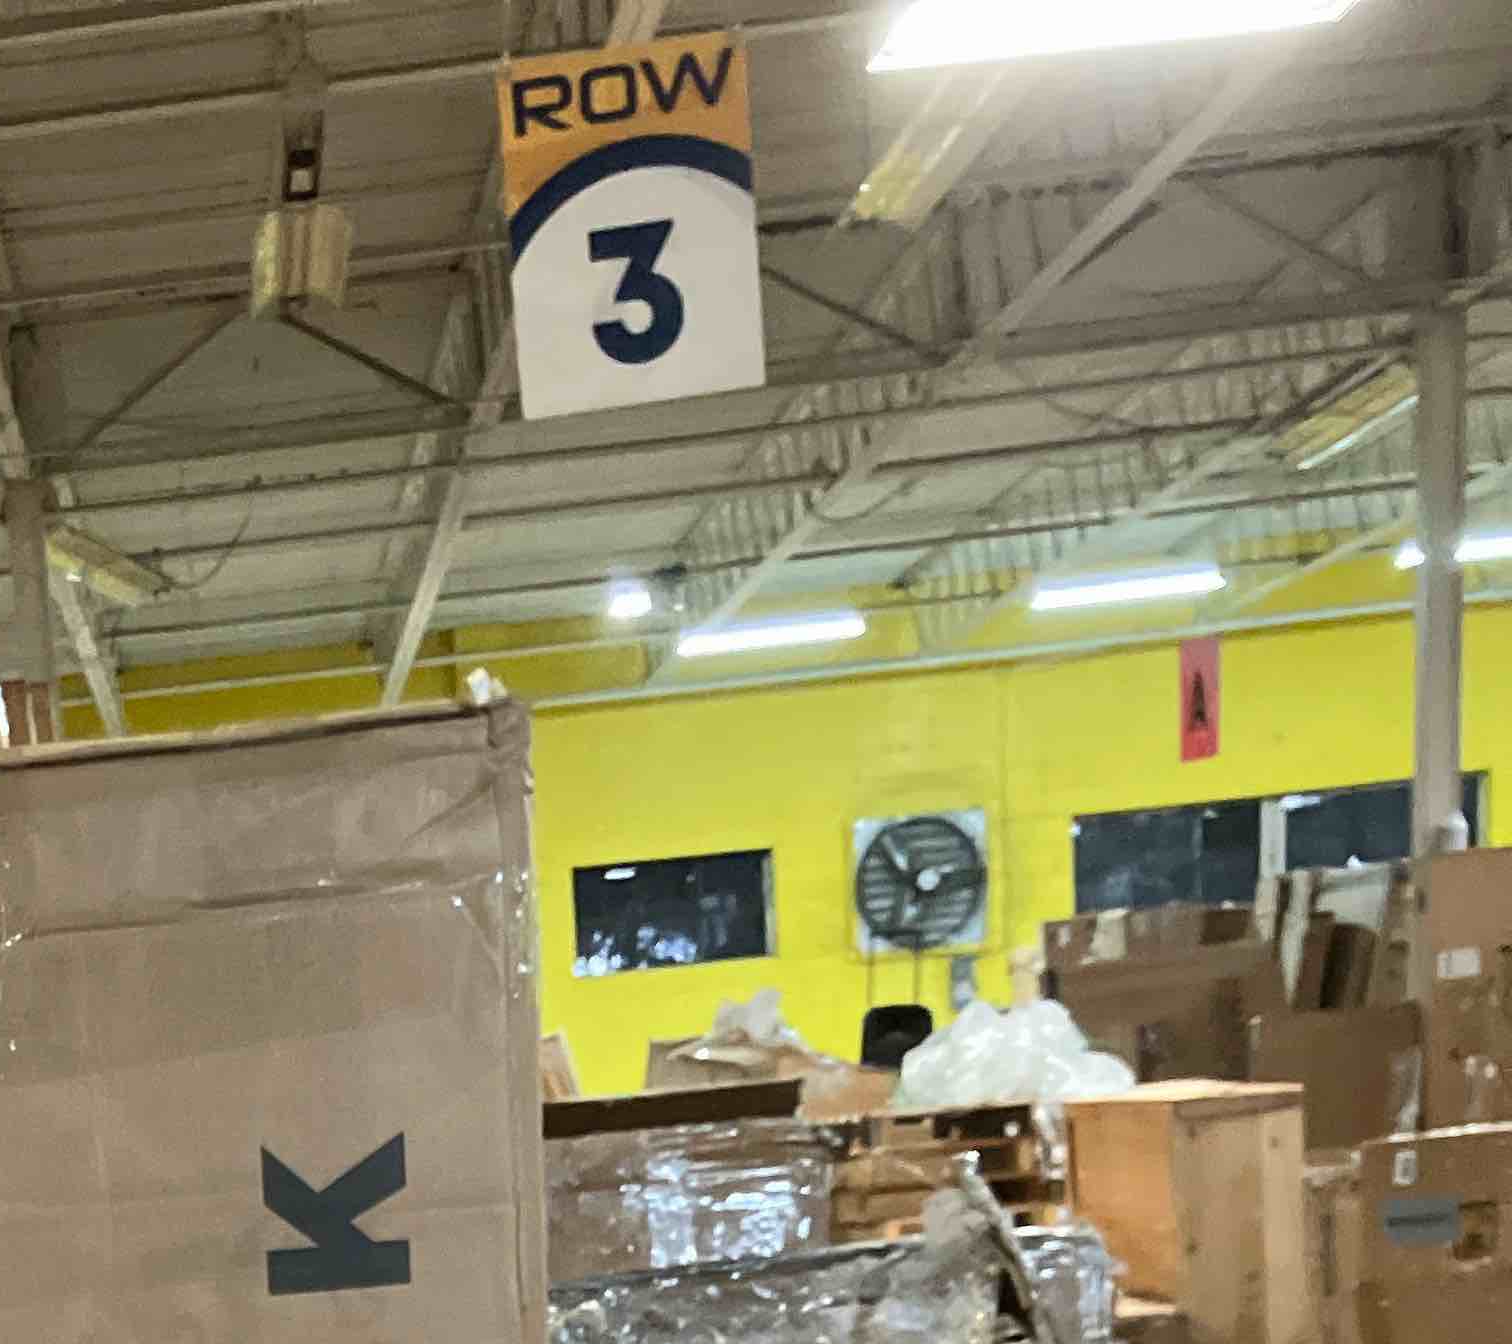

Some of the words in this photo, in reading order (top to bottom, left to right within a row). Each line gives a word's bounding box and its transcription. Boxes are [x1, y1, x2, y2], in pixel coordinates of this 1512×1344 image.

[510, 47, 735, 138] ROW
[586, 217, 685, 365] 3
[259, 1130, 413, 1296] K
